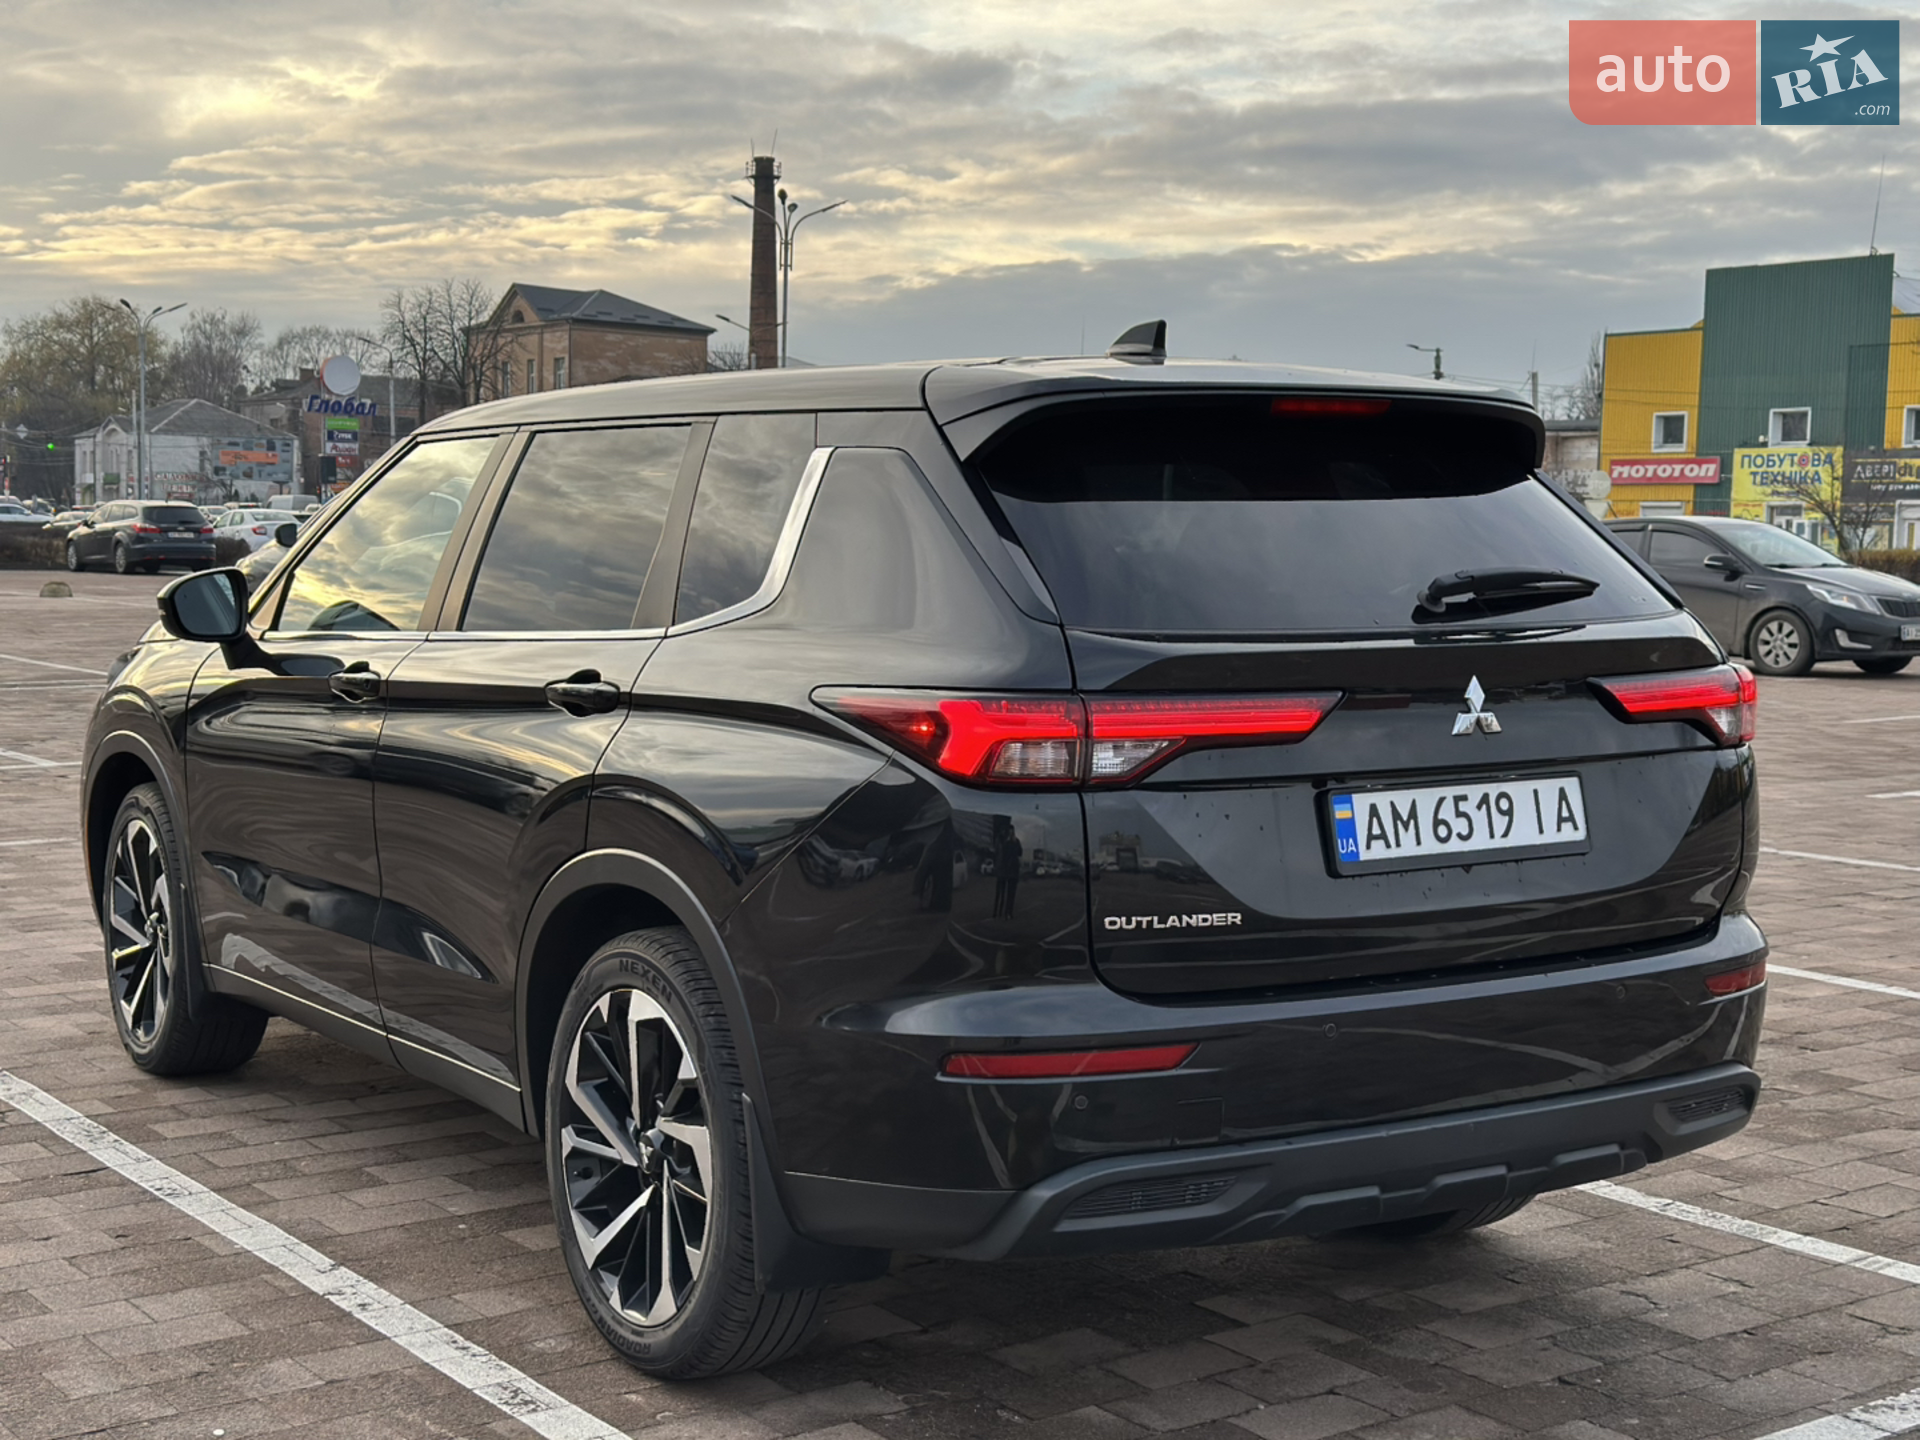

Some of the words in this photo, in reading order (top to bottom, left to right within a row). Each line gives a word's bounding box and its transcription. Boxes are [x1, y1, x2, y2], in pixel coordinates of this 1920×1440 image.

[307, 394, 377, 416] Глобал
[1741, 453, 1833, 469] ПОБУТОВА
[1611, 463, 1717, 478] МОТОТОП
[1750, 471, 1822, 486] ТЕХНІКА
[1853, 464, 1894, 479] ДВЕРІ
[1366, 798, 1422, 851] AM
[1432, 791, 1514, 844] 6519
[1533, 786, 1580, 835] IA
[1338, 838, 1357, 854] UA
[1104, 912, 1242, 930] OUTLANDER
[619, 959, 672, 1004] NEXEN
